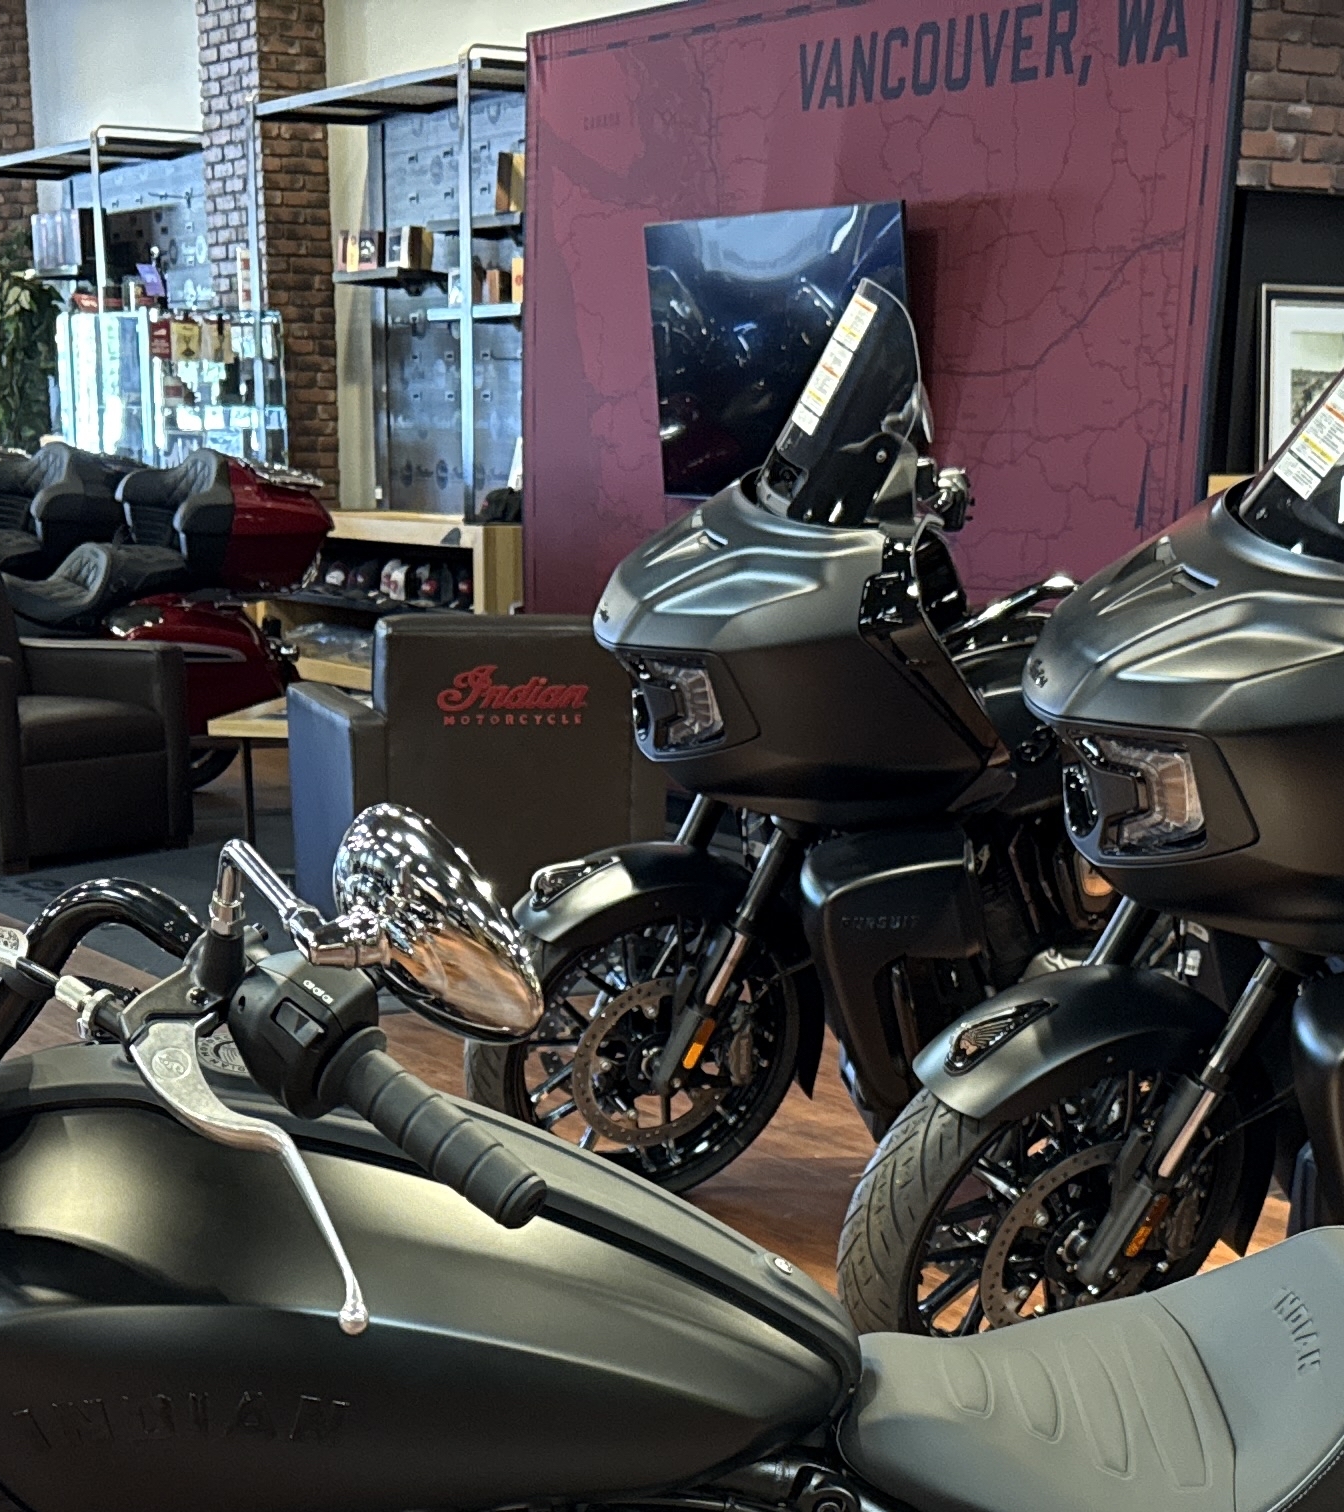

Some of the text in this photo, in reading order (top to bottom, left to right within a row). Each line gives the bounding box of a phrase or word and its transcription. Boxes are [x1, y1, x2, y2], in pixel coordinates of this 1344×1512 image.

[799, 0, 1188, 111] VANCOUVER, WA
[436, 664, 589, 712] Indian
[443, 714, 583, 727] MOTORCYCLE
[841, 914, 921, 931] PURSUIT
[12, 1390, 353, 1450] INDIAN
